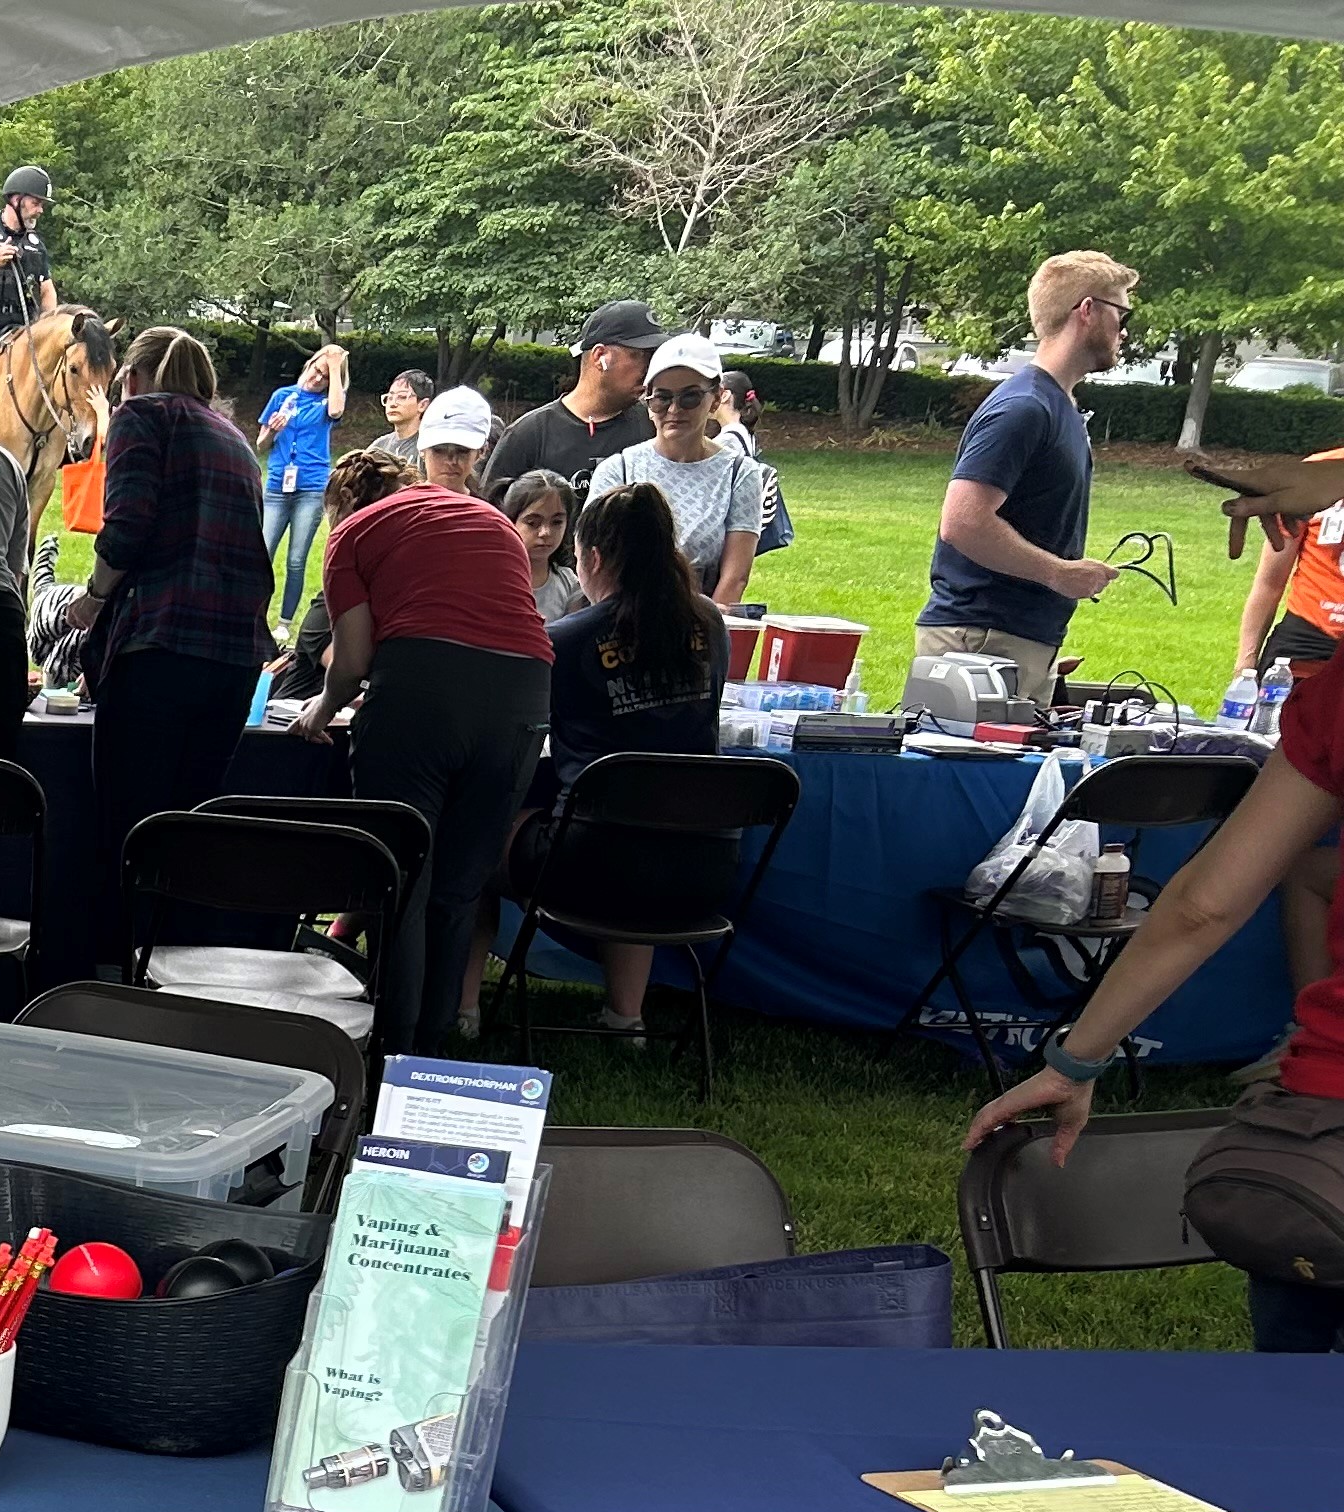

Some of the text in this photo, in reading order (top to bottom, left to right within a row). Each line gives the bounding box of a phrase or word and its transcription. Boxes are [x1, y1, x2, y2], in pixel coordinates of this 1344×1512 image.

[410, 1071, 518, 1092] DEXTROMETHORPHAN
[362, 1145, 410, 1161] HEROIN
[355, 1214, 442, 1238] Vaping &
[350, 1232, 450, 1259] Marijuana
[347, 1252, 472, 1283] Concentrates
[325, 1366, 381, 1384] What is
[323, 1383, 384, 1402] Vaping?
